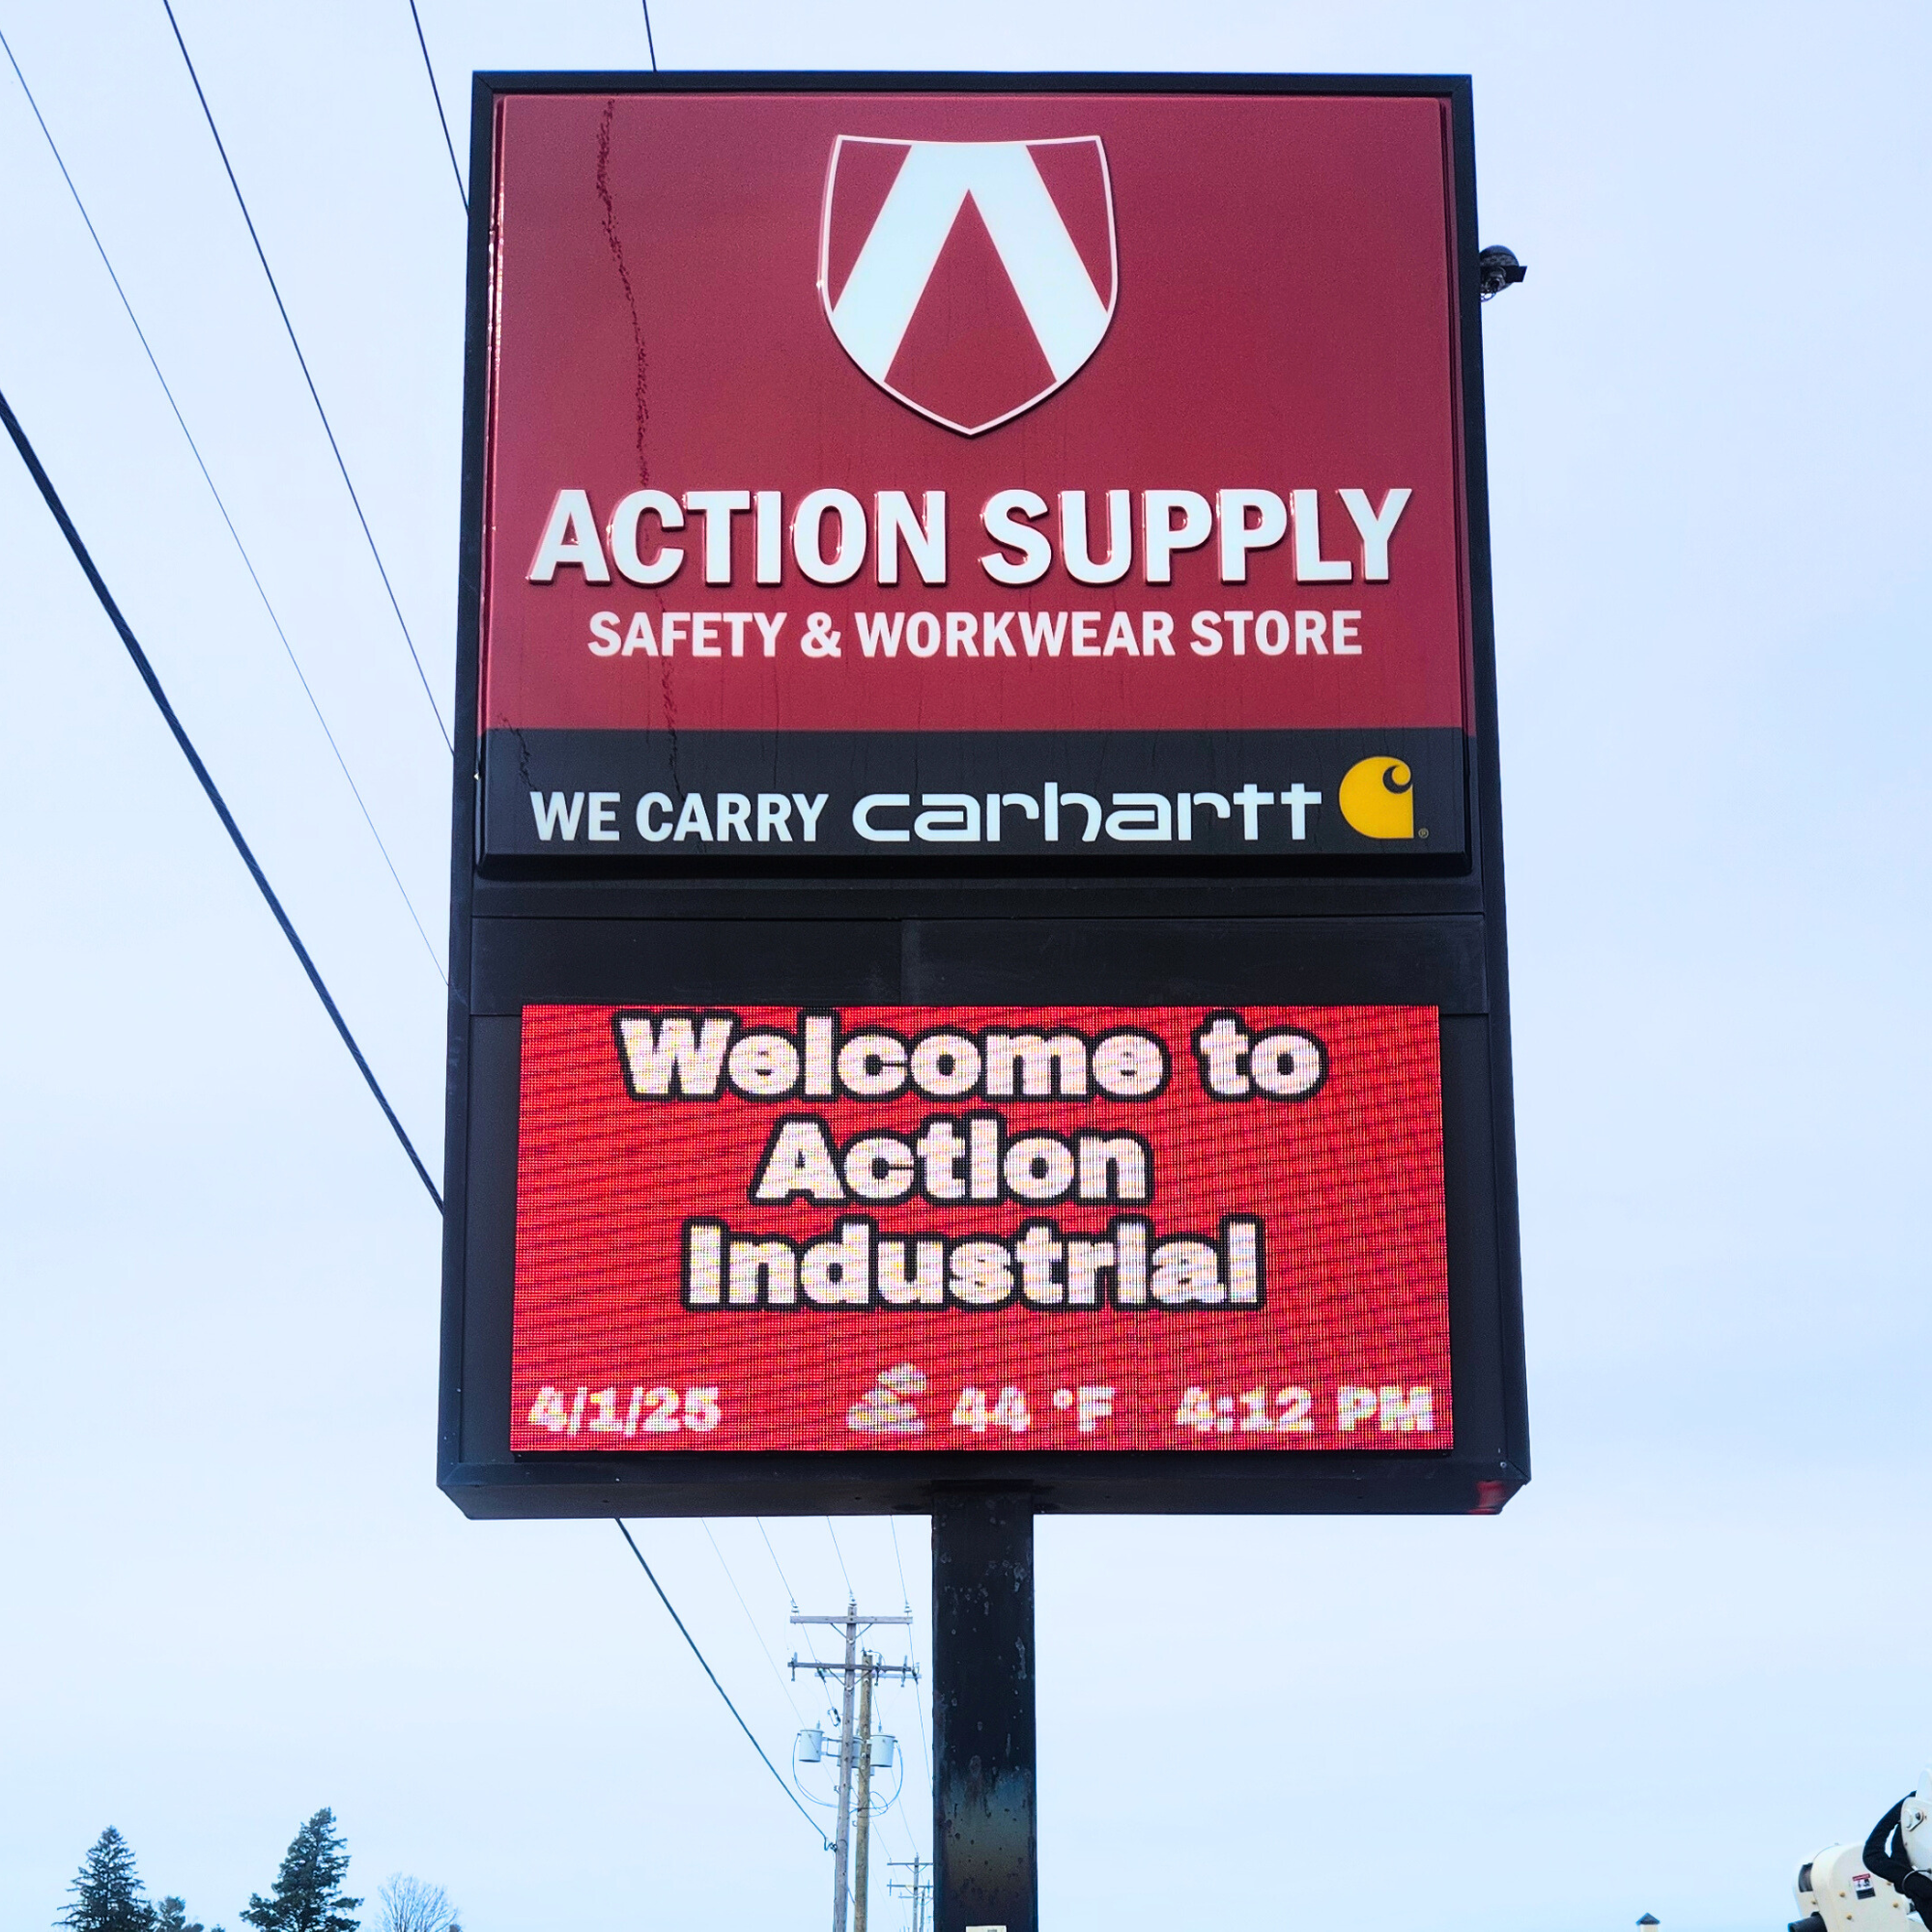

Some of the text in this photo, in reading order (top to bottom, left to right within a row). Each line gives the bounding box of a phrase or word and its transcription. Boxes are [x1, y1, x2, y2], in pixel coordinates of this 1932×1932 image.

[526, 488, 1412, 585] ACTION SUPPLY
[587, 610, 1362, 658] SAFETY & WORKWEAR STORE
[529, 781, 1322, 842] WE CARRY carhartt
[618, 1014, 1322, 1097] Welcome to
[528, 1386, 721, 1435] 4/1/25
[952, 1385, 1032, 1433] 44
[1176, 1386, 1434, 1434] 4:12 PM
